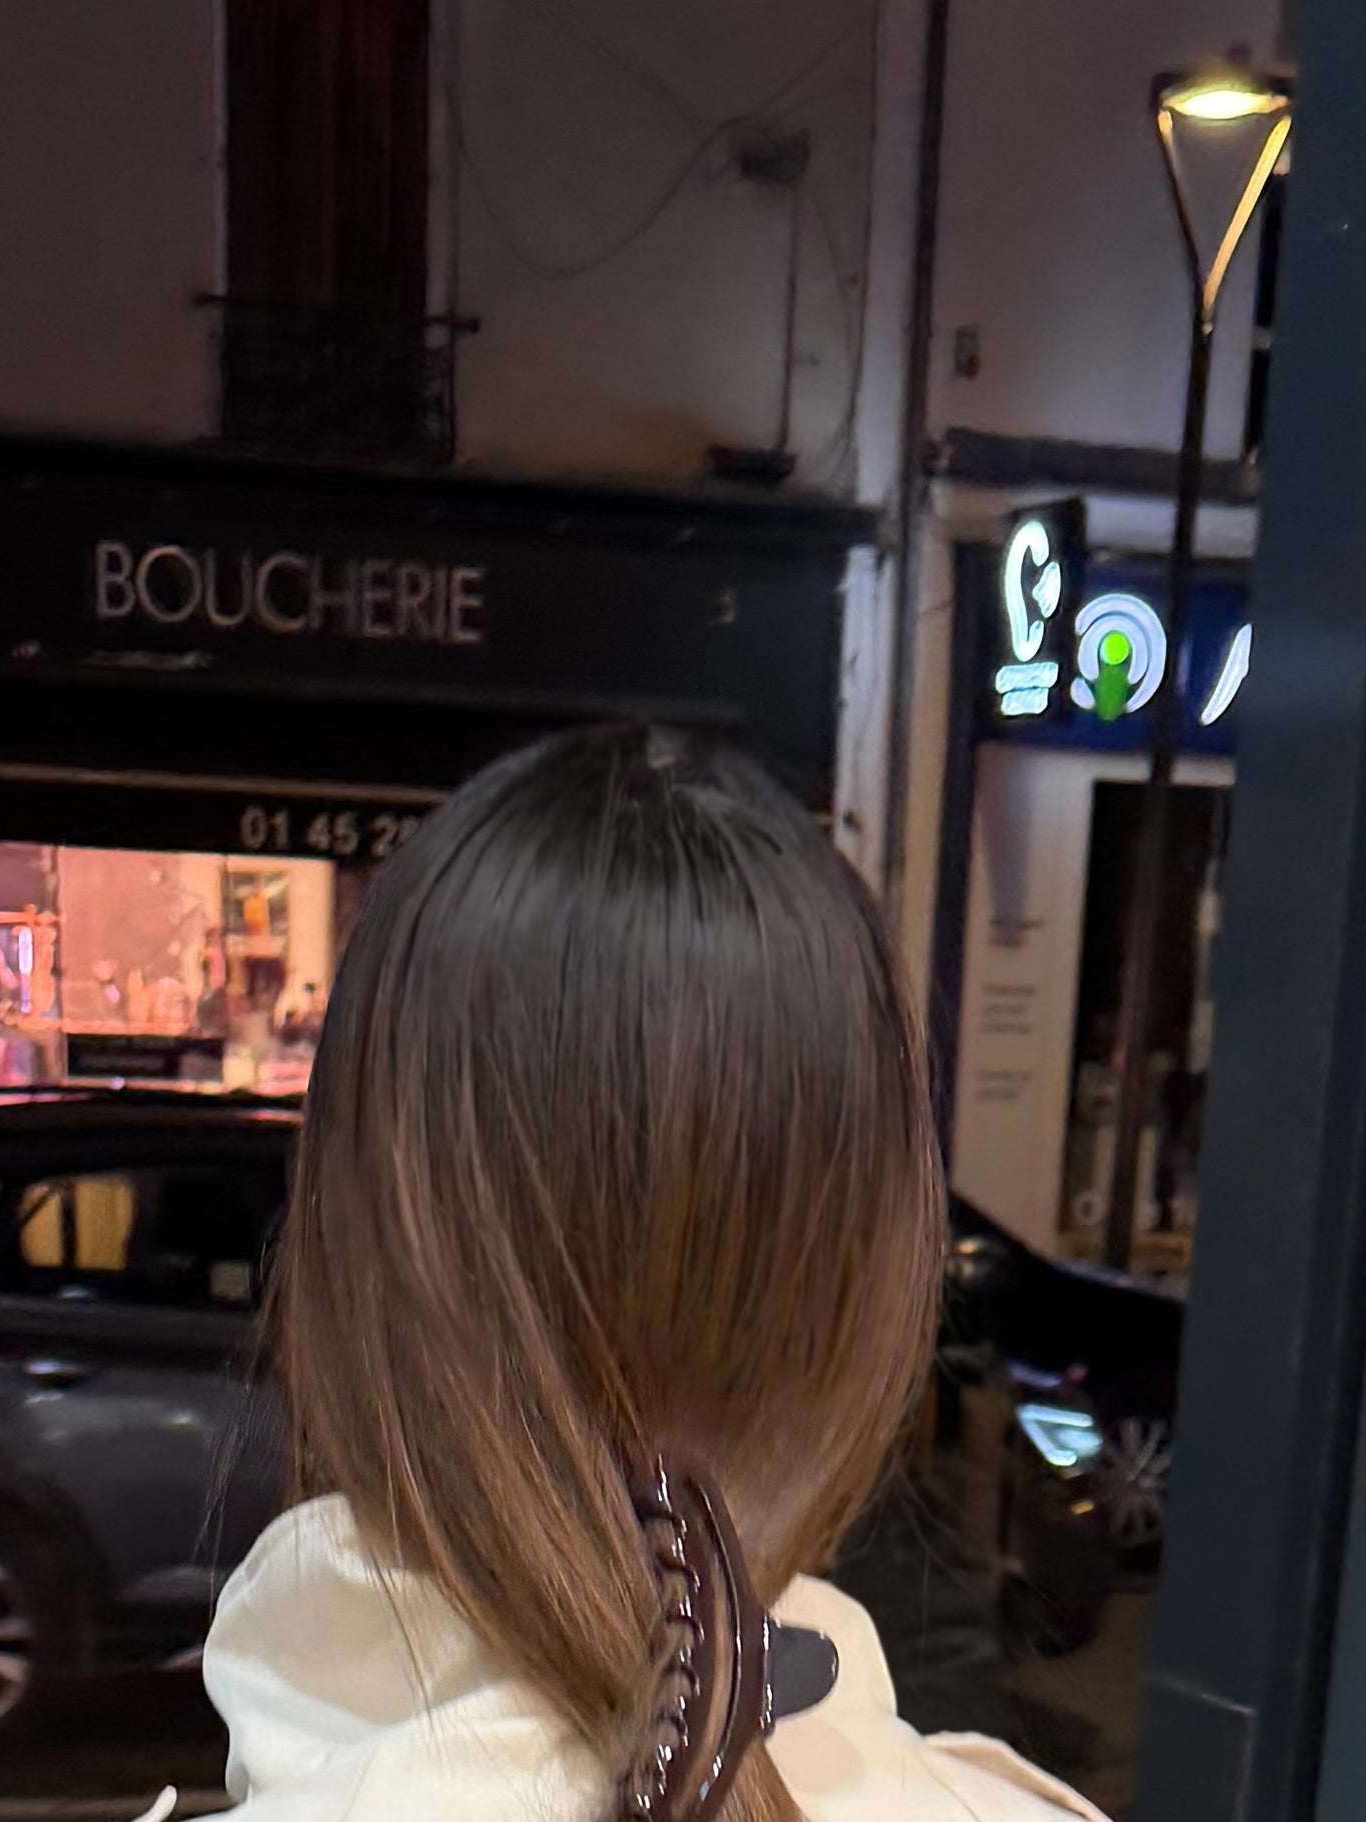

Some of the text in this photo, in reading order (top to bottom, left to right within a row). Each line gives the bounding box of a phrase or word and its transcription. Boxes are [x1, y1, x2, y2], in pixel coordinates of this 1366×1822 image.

[94, 539, 486, 644] BOUCHERIE
[239, 805, 290, 849] 01
[306, 809, 360, 855] 45
